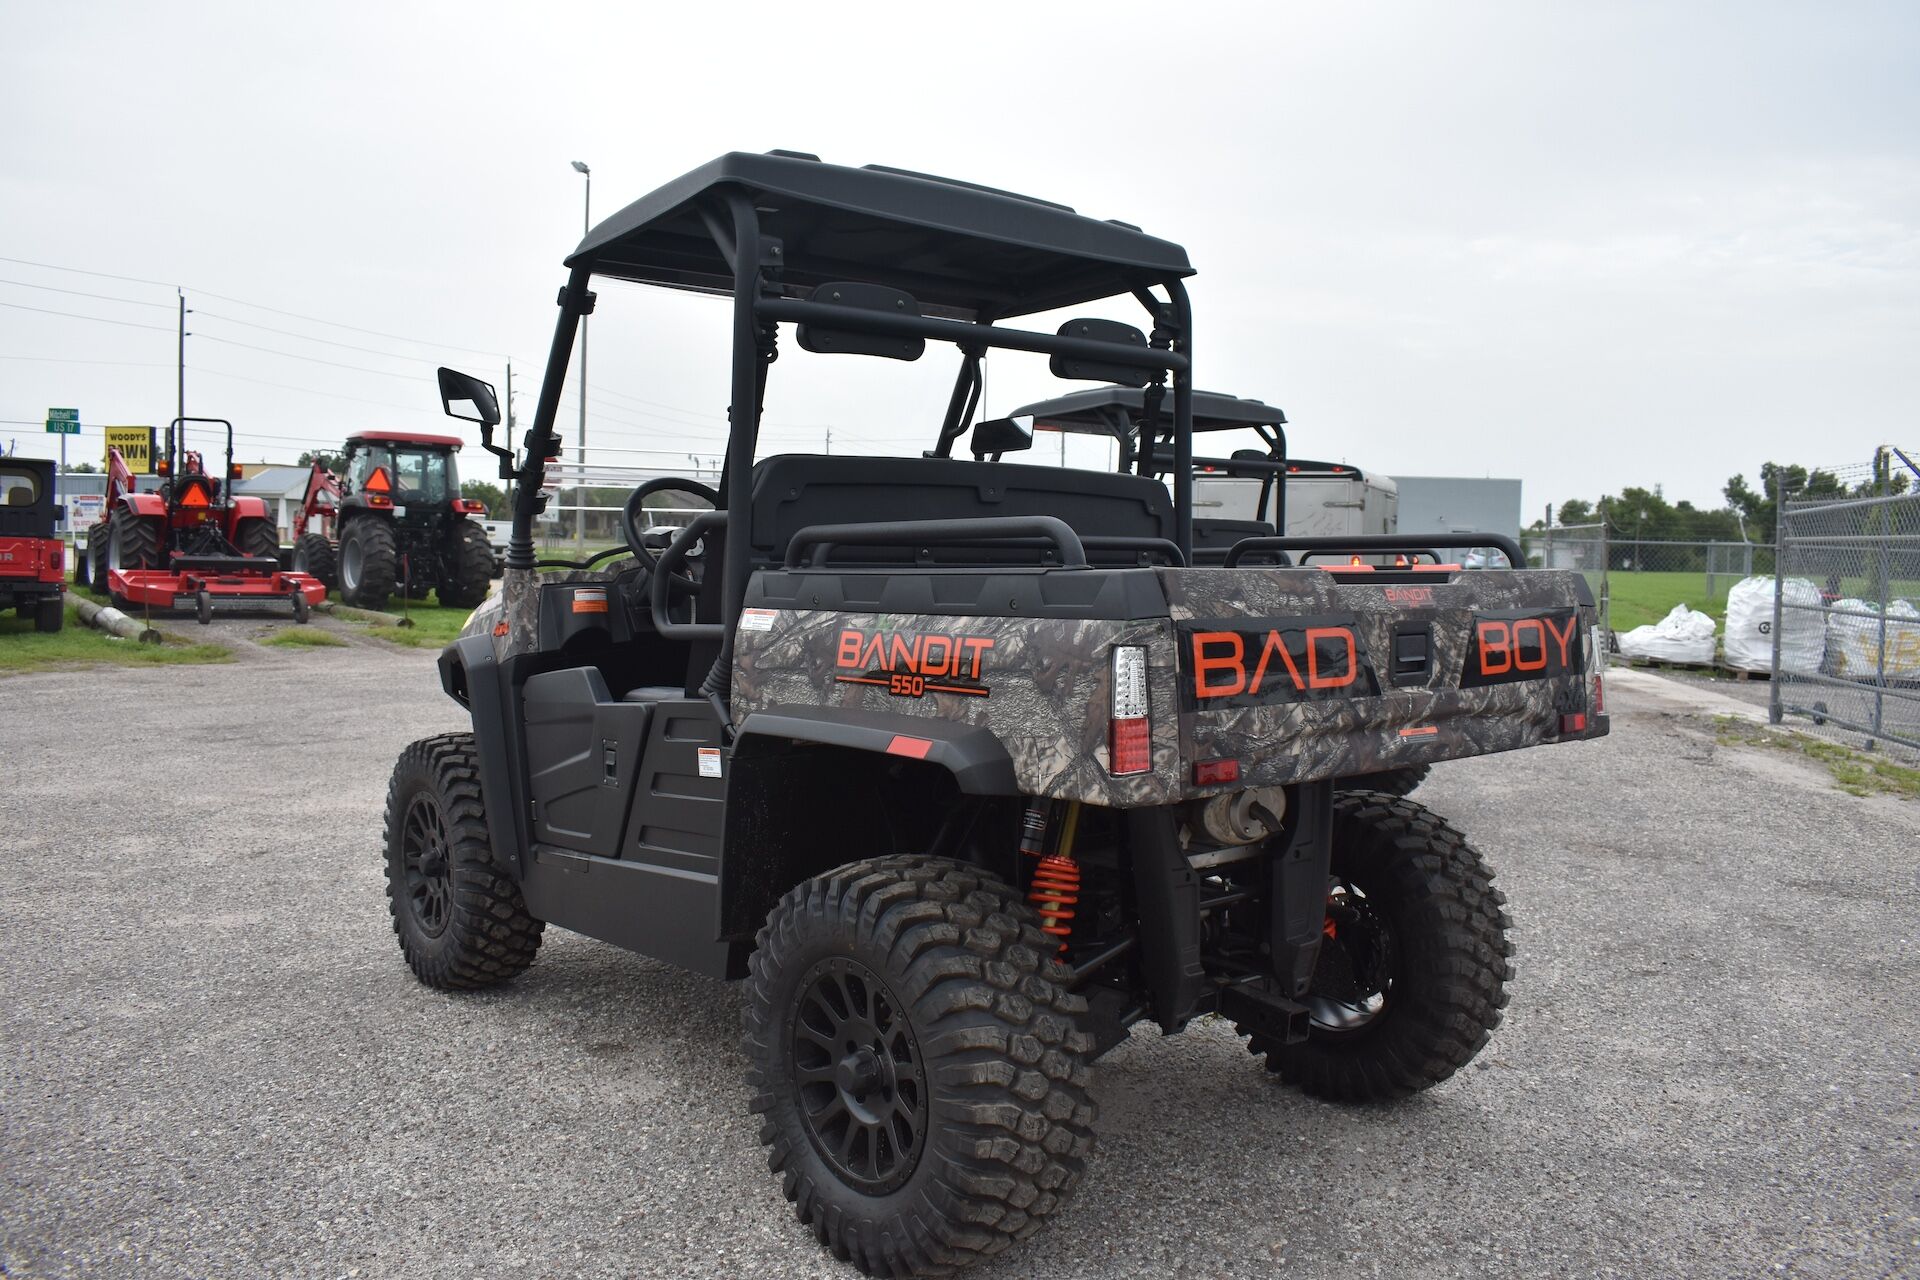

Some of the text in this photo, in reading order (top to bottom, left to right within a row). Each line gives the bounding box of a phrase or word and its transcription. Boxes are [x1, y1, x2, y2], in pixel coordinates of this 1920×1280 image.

[49, 410, 70, 419] Mitchell
[54, 422, 75, 432] US 17
[110, 433, 146, 441] WOODY'S
[1384, 588, 1432, 602] BANDIT
[836, 630, 995, 679] BANDIT
[1193, 616, 1577, 698] BAD BOY
[890, 674, 924, 696] 550
